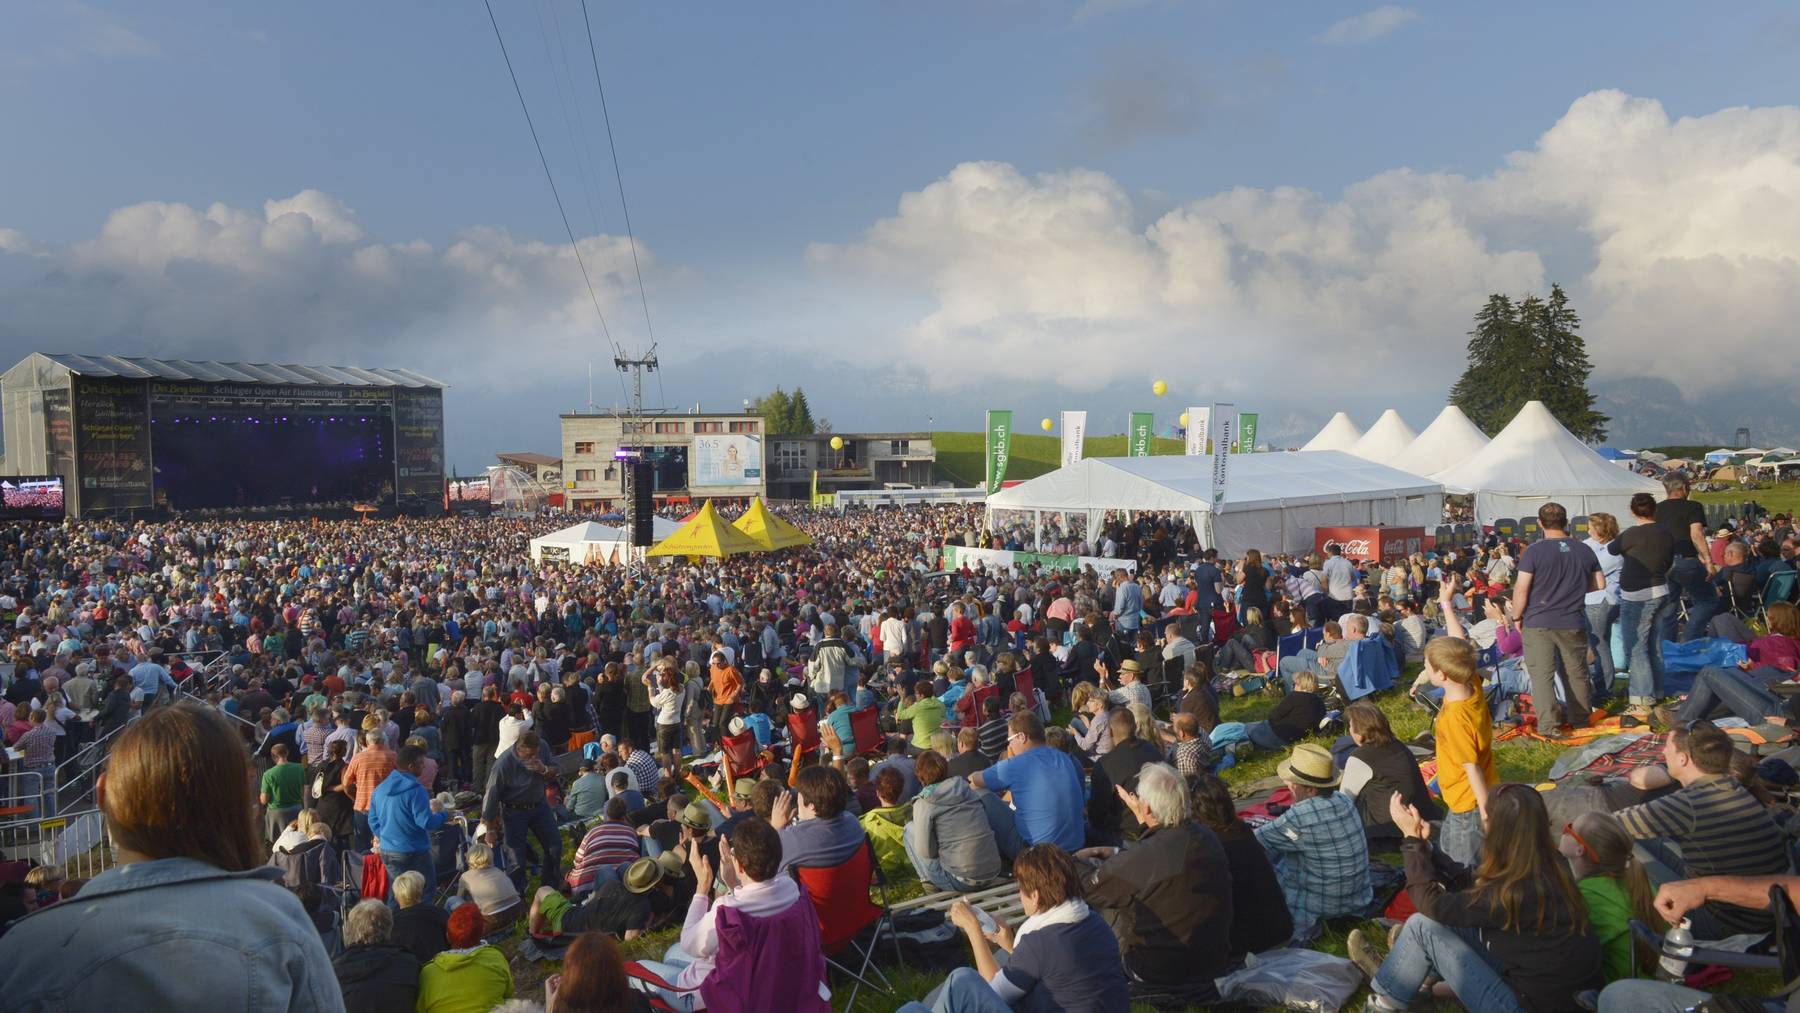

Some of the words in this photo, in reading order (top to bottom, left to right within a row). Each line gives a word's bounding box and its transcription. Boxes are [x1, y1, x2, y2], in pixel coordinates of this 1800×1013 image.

[213, 384, 252, 397] Schlager
[254, 385, 277, 398] Open
[279, 387, 292, 397] Air
[294, 388, 343, 400] Flumserberg
[1219, 420, 1230, 485] Kantonalbank
